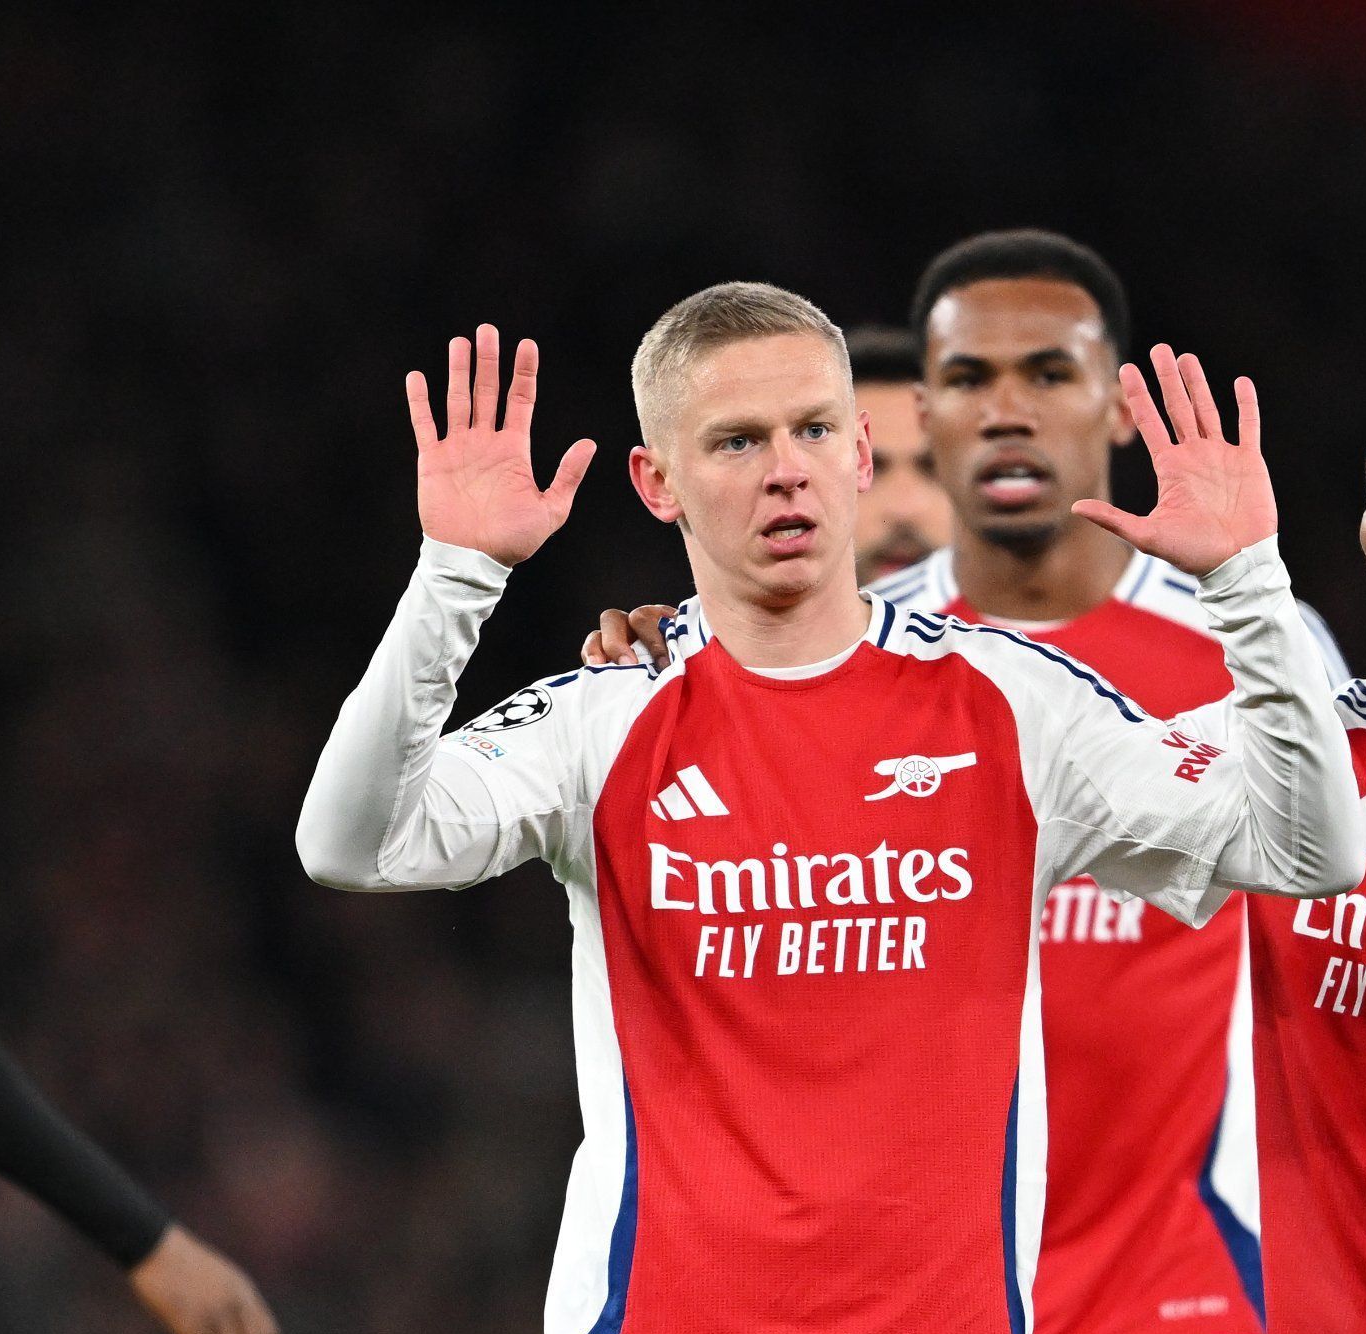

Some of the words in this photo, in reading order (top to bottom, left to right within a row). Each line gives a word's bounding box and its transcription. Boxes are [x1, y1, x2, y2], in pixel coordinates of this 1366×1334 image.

[647, 839, 973, 915] Emirates
[694, 924, 763, 979] FLY
[777, 916, 927, 976] BETTER
